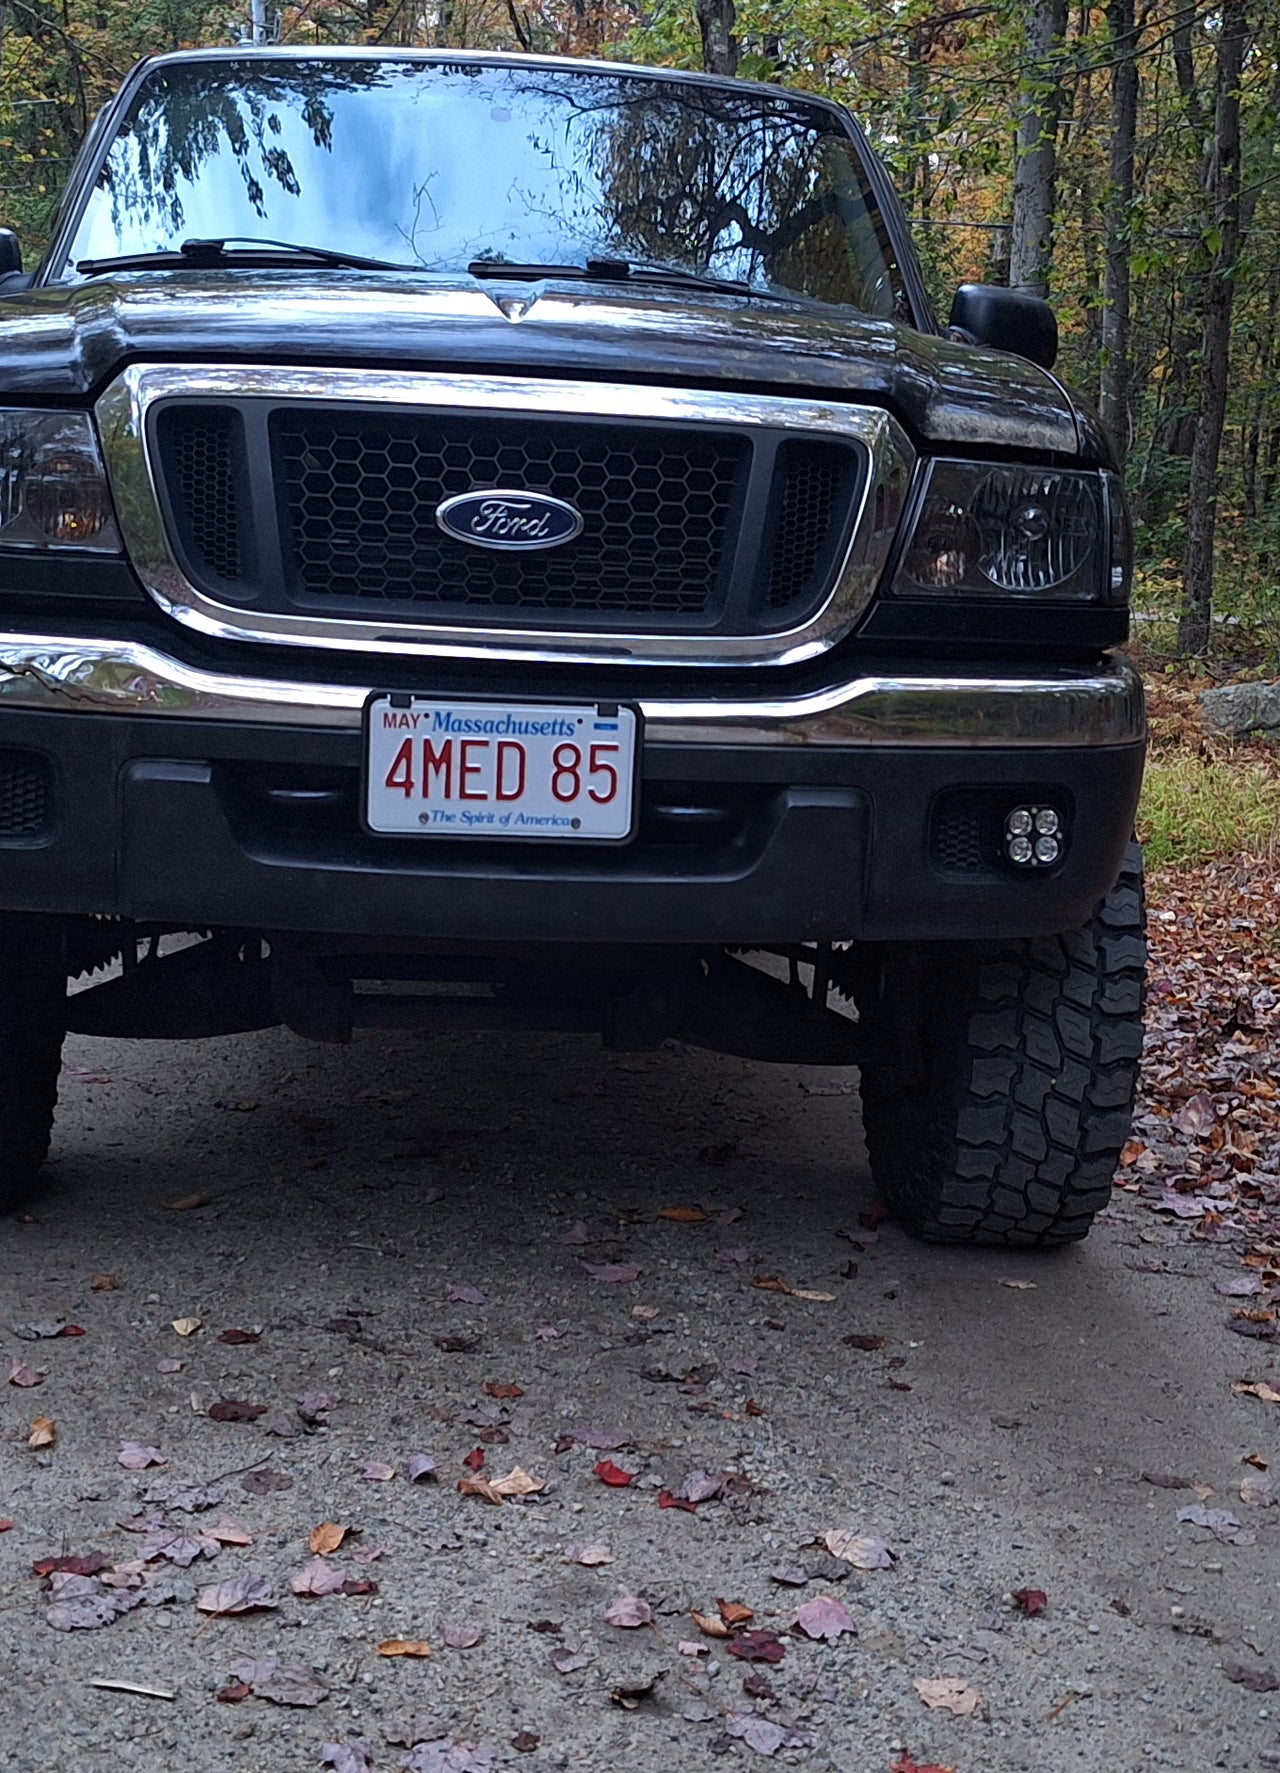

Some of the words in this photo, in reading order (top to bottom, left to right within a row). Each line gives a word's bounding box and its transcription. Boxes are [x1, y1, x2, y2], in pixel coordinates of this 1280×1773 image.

[471, 500, 551, 537] Ford
[383, 712, 420, 729] MAY
[432, 711, 576, 736] Massachusetts
[385, 737, 526, 801] 4MED
[551, 743, 619, 804] 85
[431, 809, 457, 824] The
[459, 810, 496, 827] Spirit
[498, 812, 513, 828] of
[514, 812, 570, 827] America
